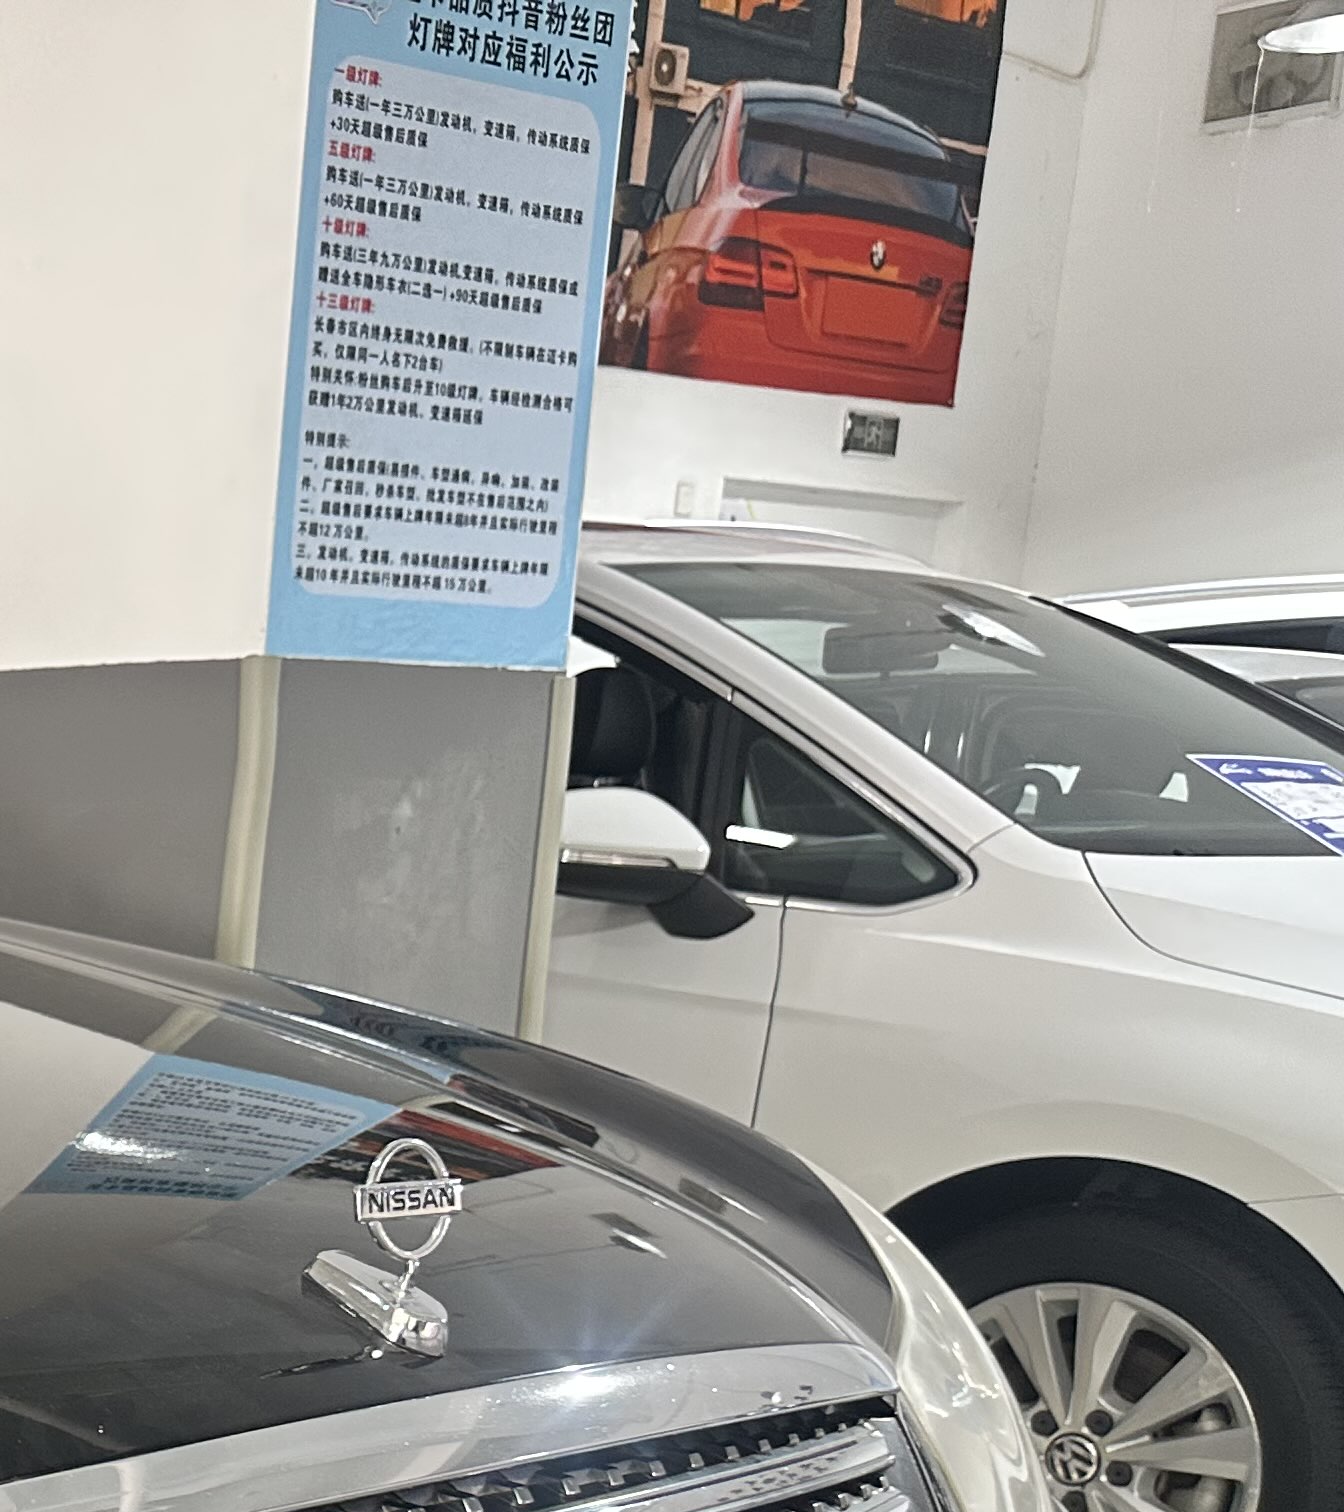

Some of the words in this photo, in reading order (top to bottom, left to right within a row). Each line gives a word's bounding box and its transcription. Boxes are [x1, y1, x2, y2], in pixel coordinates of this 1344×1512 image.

[407, 13, 599, 86] 灯牌对应福利公示
[368, 1187, 455, 1213] NISSAN
